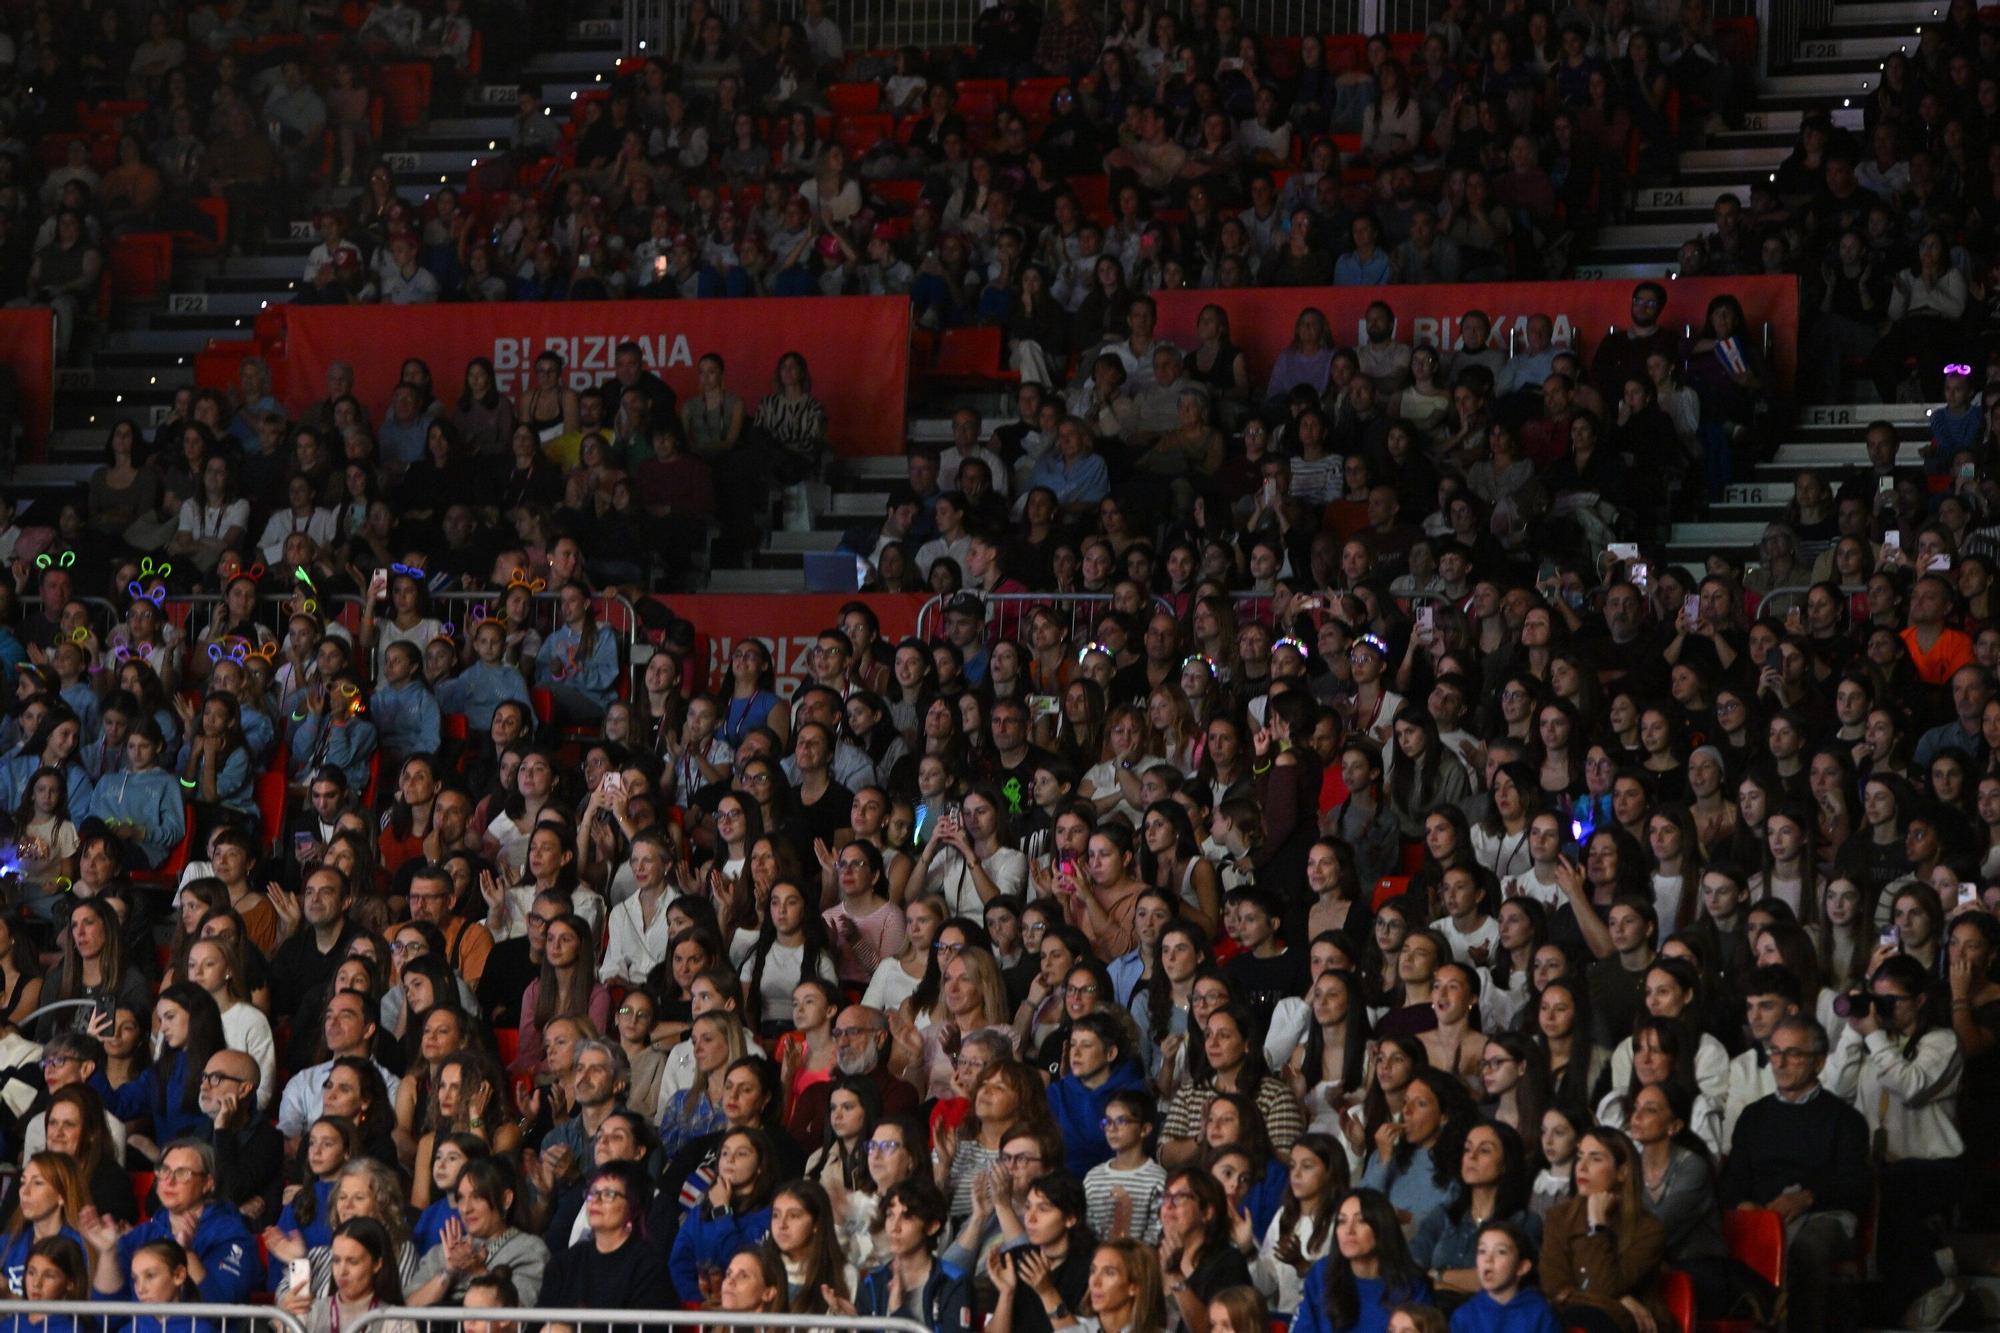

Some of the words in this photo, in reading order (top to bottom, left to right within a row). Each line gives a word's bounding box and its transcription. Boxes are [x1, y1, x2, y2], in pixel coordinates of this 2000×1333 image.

[1806, 42, 1837, 58] F28
[1652, 191, 1684, 206] F24
[174, 297, 203, 311] F22
[494, 336, 531, 369] B!
[1814, 409, 1850, 424] F18
[1726, 487, 1762, 503] F16
